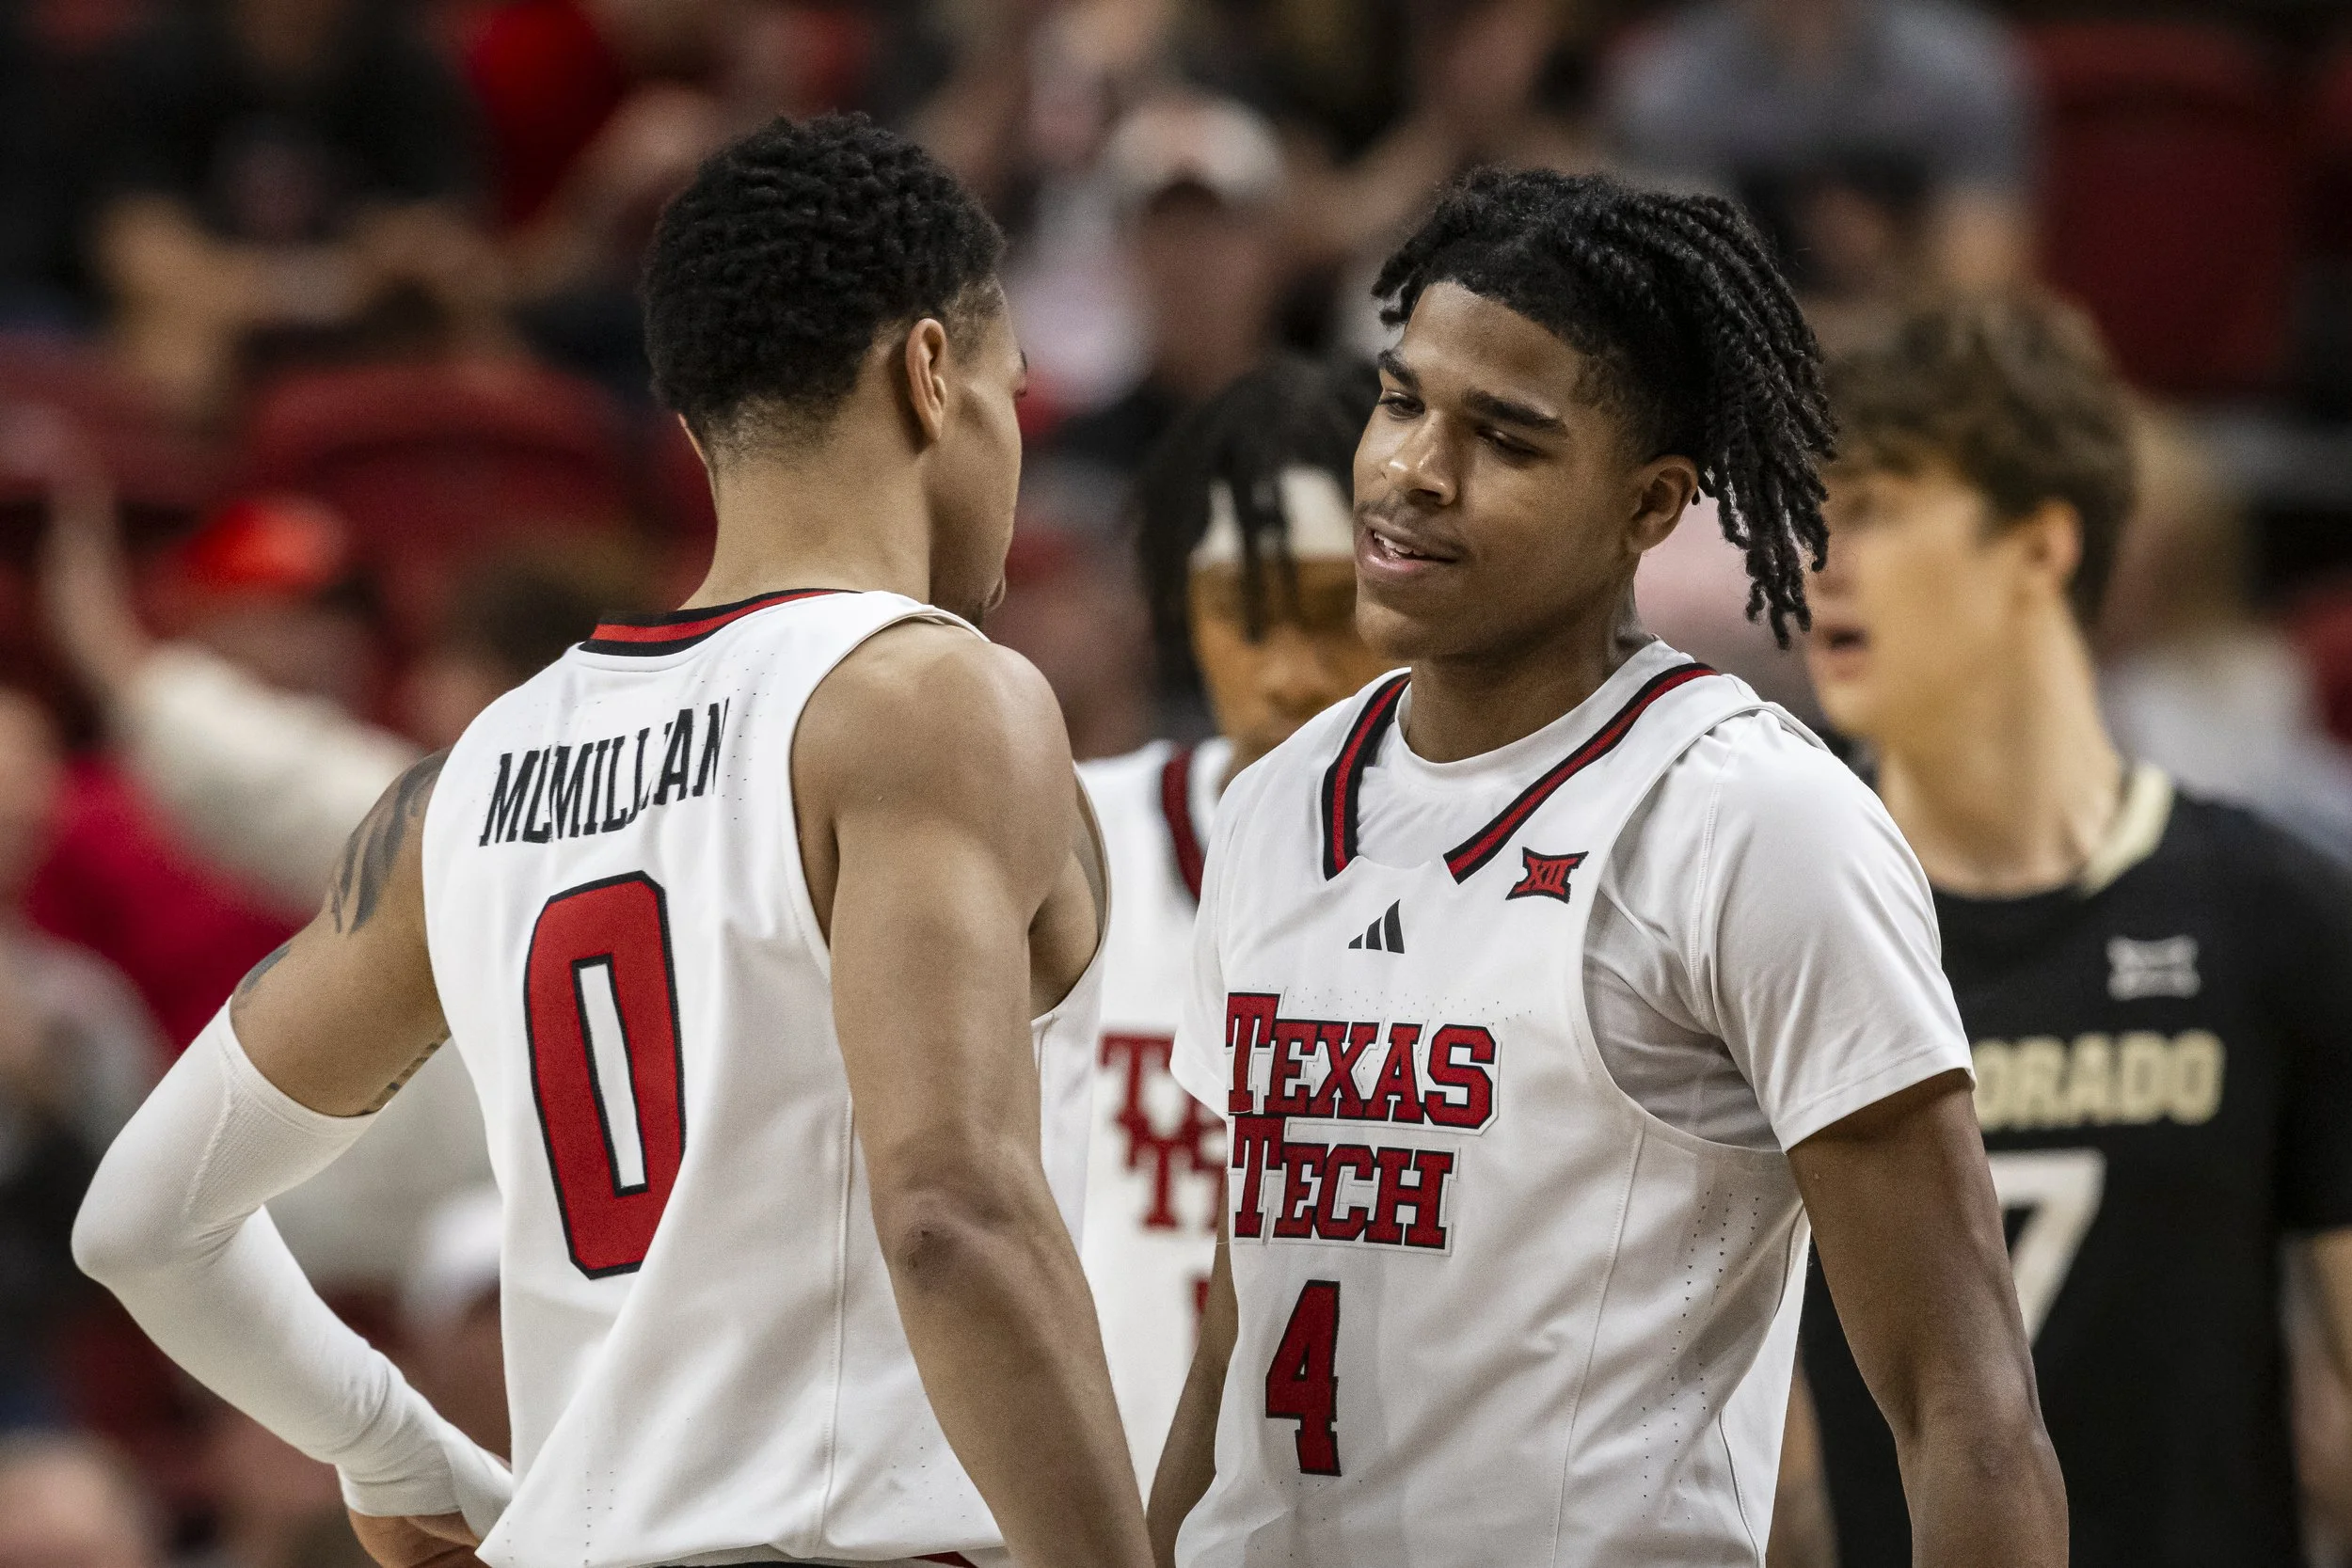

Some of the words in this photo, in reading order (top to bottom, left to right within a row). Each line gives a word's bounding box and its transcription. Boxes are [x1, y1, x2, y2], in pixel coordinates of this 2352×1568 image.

[479, 697, 730, 847] MCMILLAN
[524, 870, 686, 1279] 0
[1226, 992, 1499, 1130] TEXAS
[1972, 1028, 2226, 1131] ORADO
[1232, 1117, 1454, 1249] TECH
[1265, 1279, 1343, 1476] 4
